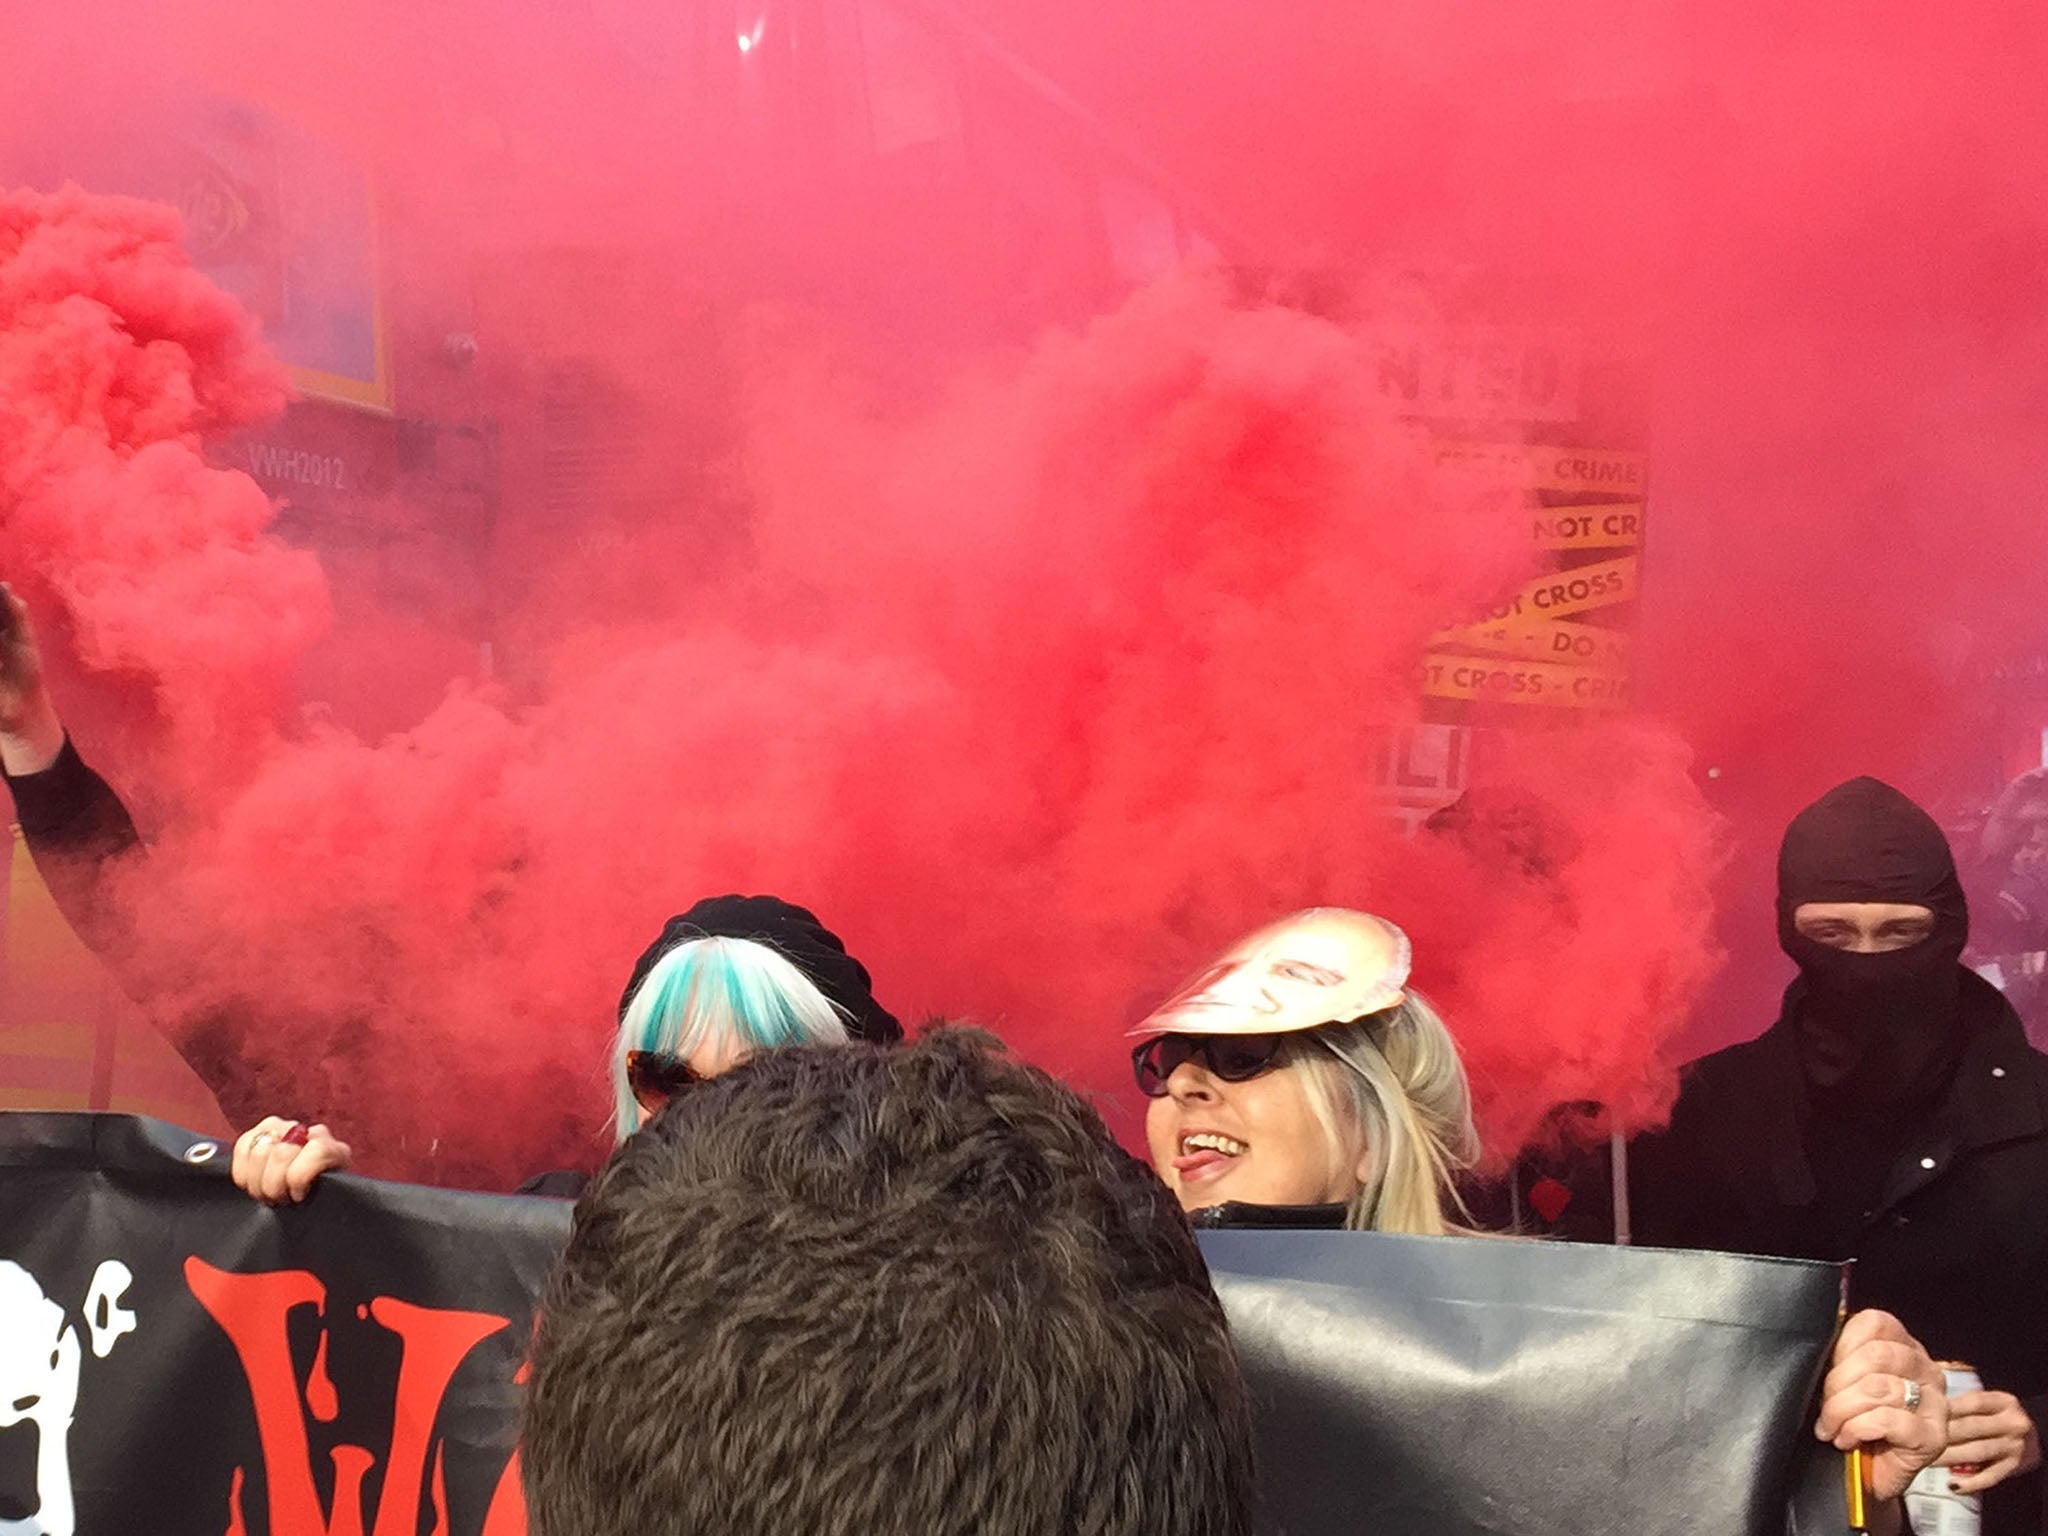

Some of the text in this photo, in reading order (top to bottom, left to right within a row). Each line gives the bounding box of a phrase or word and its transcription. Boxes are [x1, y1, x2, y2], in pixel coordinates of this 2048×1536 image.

[247, 441, 345, 490] VWH2012
[1554, 457, 1640, 484] CRIME
[1532, 515, 1592, 541] NOT
[1480, 570, 1624, 622] OT CROSS
[1552, 631, 1596, 658] DO
[1453, 667, 1544, 695] CROSS
[184, 1255, 545, 1536] W
